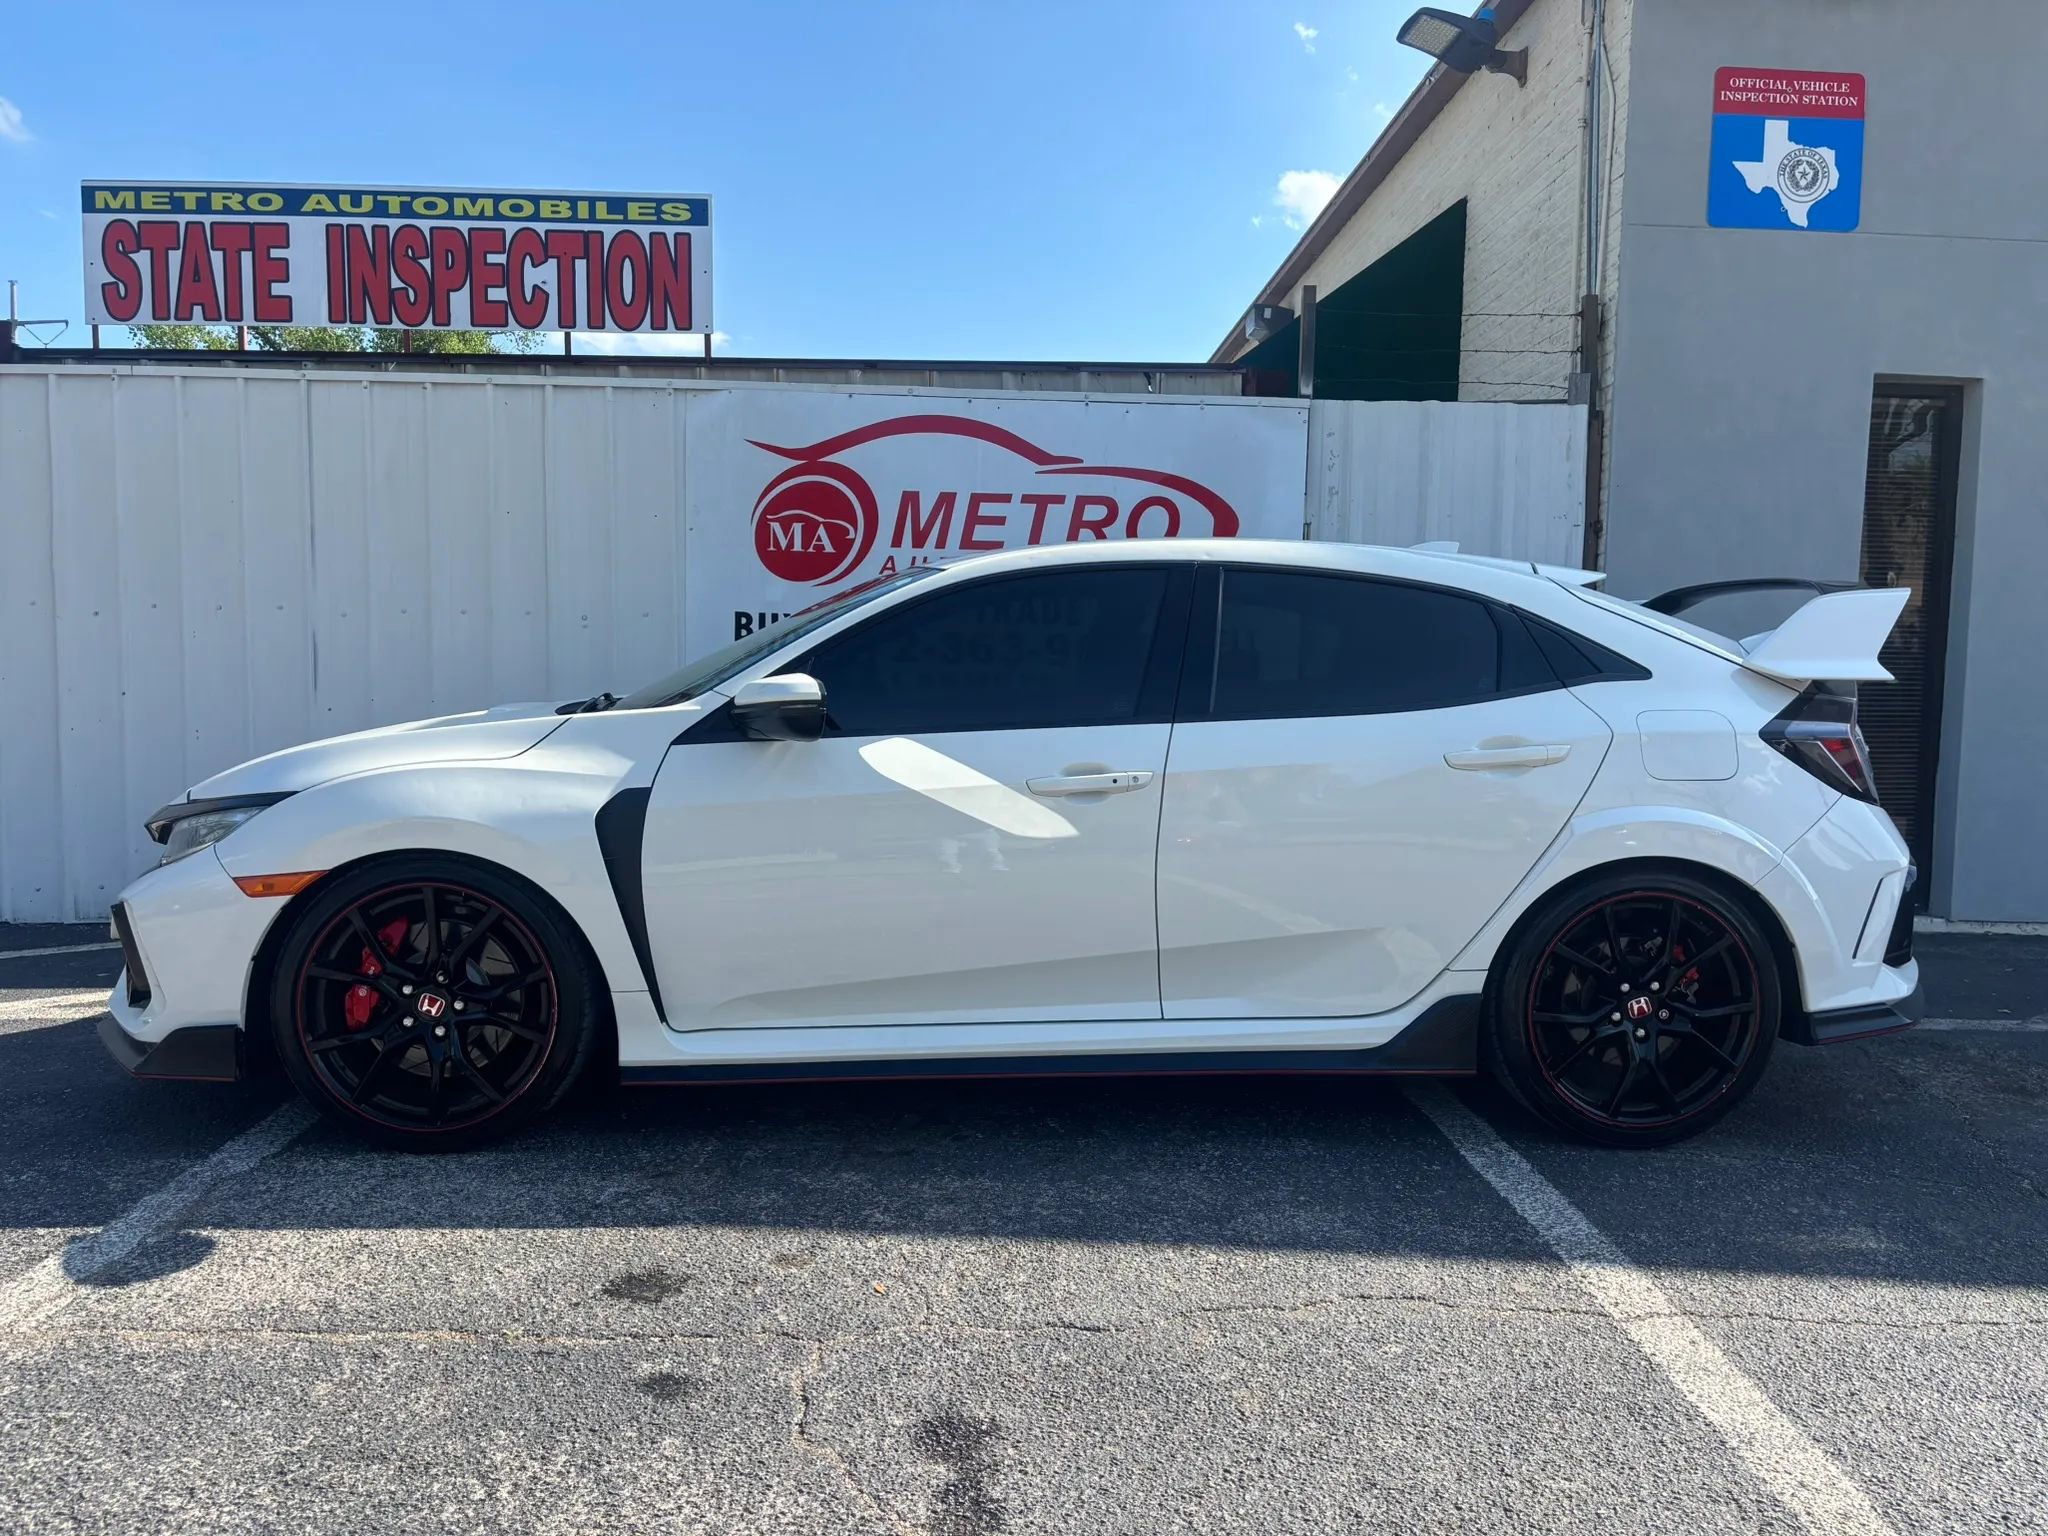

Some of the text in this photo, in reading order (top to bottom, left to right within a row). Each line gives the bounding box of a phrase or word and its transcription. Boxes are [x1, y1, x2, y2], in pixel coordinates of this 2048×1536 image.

[1720, 91, 1858, 106] INSPECTION STATION
[1730, 78, 1850, 92] OFFICIAL VEHICLE
[94, 190, 693, 223] METRO AUTOMOBILES
[100, 219, 693, 331] STATE INSPECTION
[890, 490, 1181, 550] METRO
[767, 521, 837, 554] MA
